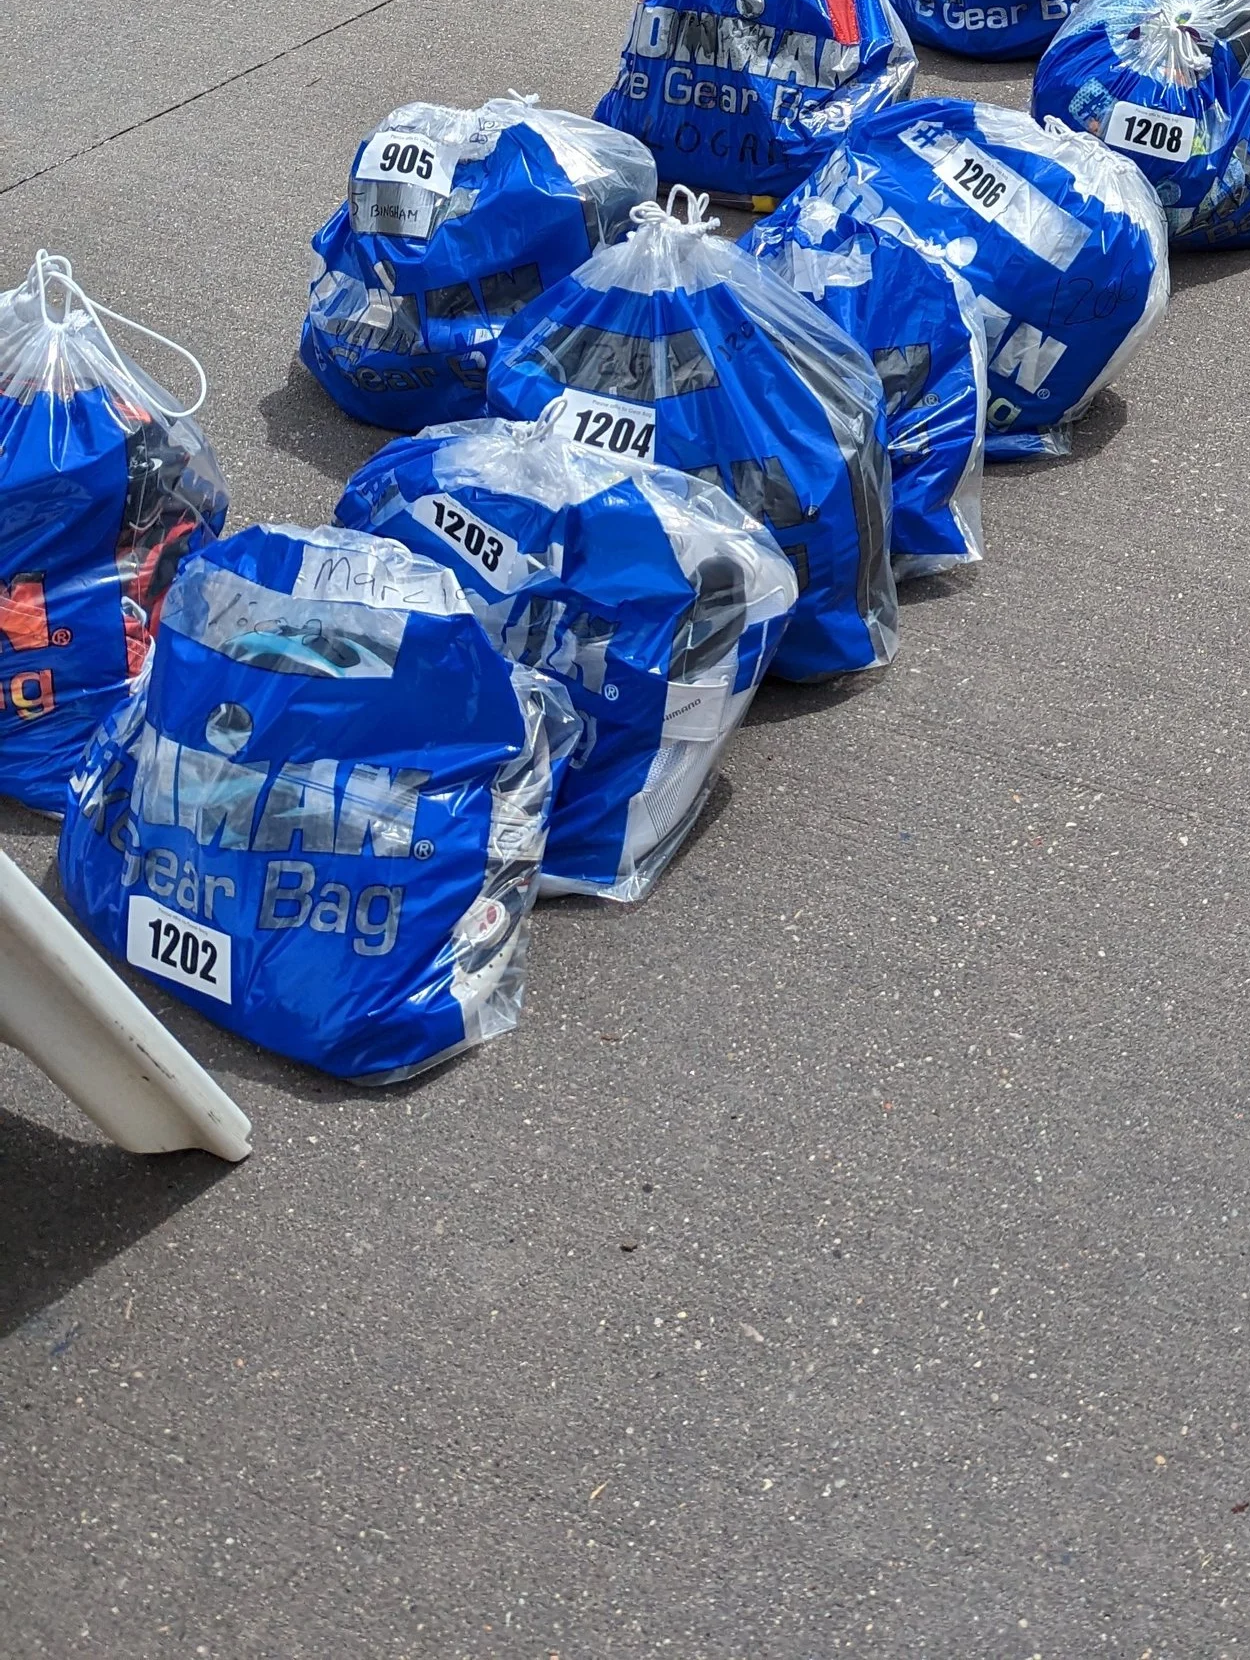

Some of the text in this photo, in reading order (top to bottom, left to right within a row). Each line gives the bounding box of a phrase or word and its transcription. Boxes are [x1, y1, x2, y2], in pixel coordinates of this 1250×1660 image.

[664, 67, 758, 115] Gear
[1124, 115, 1183, 153] 1208
[379, 141, 434, 180] 905
[952, 157, 1007, 209] 1206
[370, 203, 419, 223] BINGHAM
[573, 409, 656, 458] 1204
[432, 499, 504, 573] 1203
[258, 857, 407, 958] Bag
[148, 917, 219, 986] 1202
